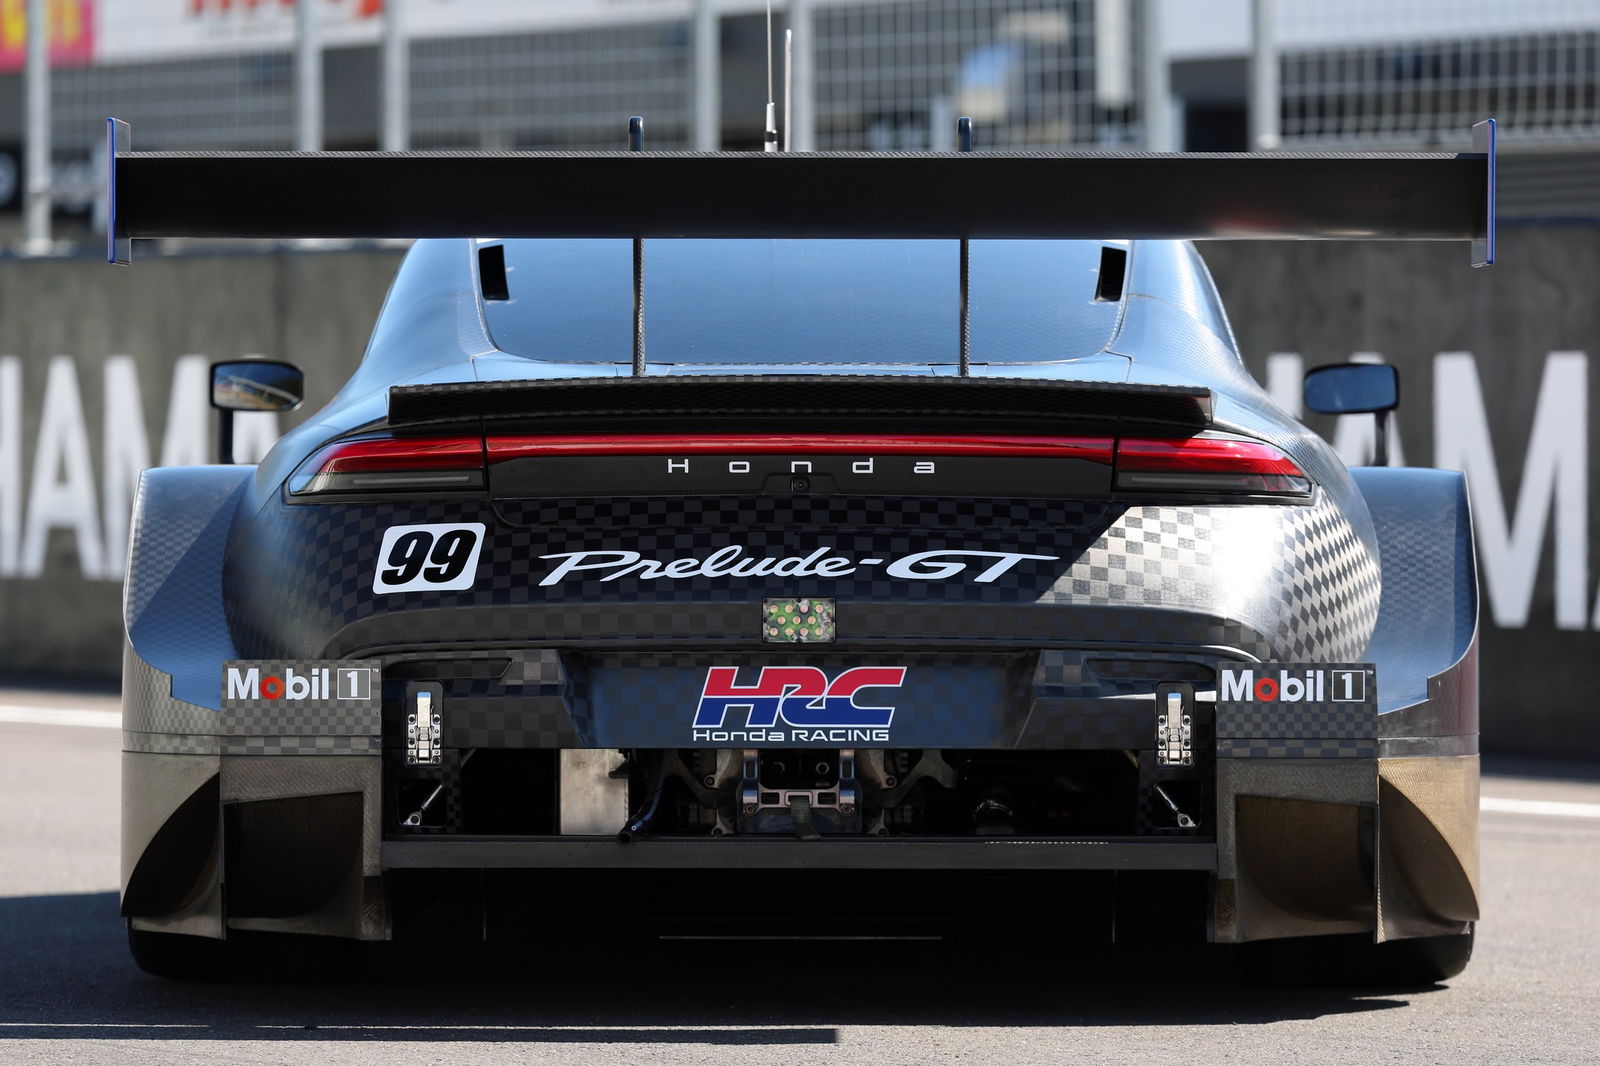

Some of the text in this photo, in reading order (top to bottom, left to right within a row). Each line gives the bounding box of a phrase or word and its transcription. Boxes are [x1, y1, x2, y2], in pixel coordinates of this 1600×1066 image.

[667, 457, 935, 474] Honda
[381, 529, 477, 585] 99
[538, 545, 1060, 587] Prelude-GT
[227, 668, 330, 700] Mobil
[692, 666, 907, 728] HRC
[1221, 669, 1325, 702] Mobil
[692, 729, 889, 742] Honda RACING
